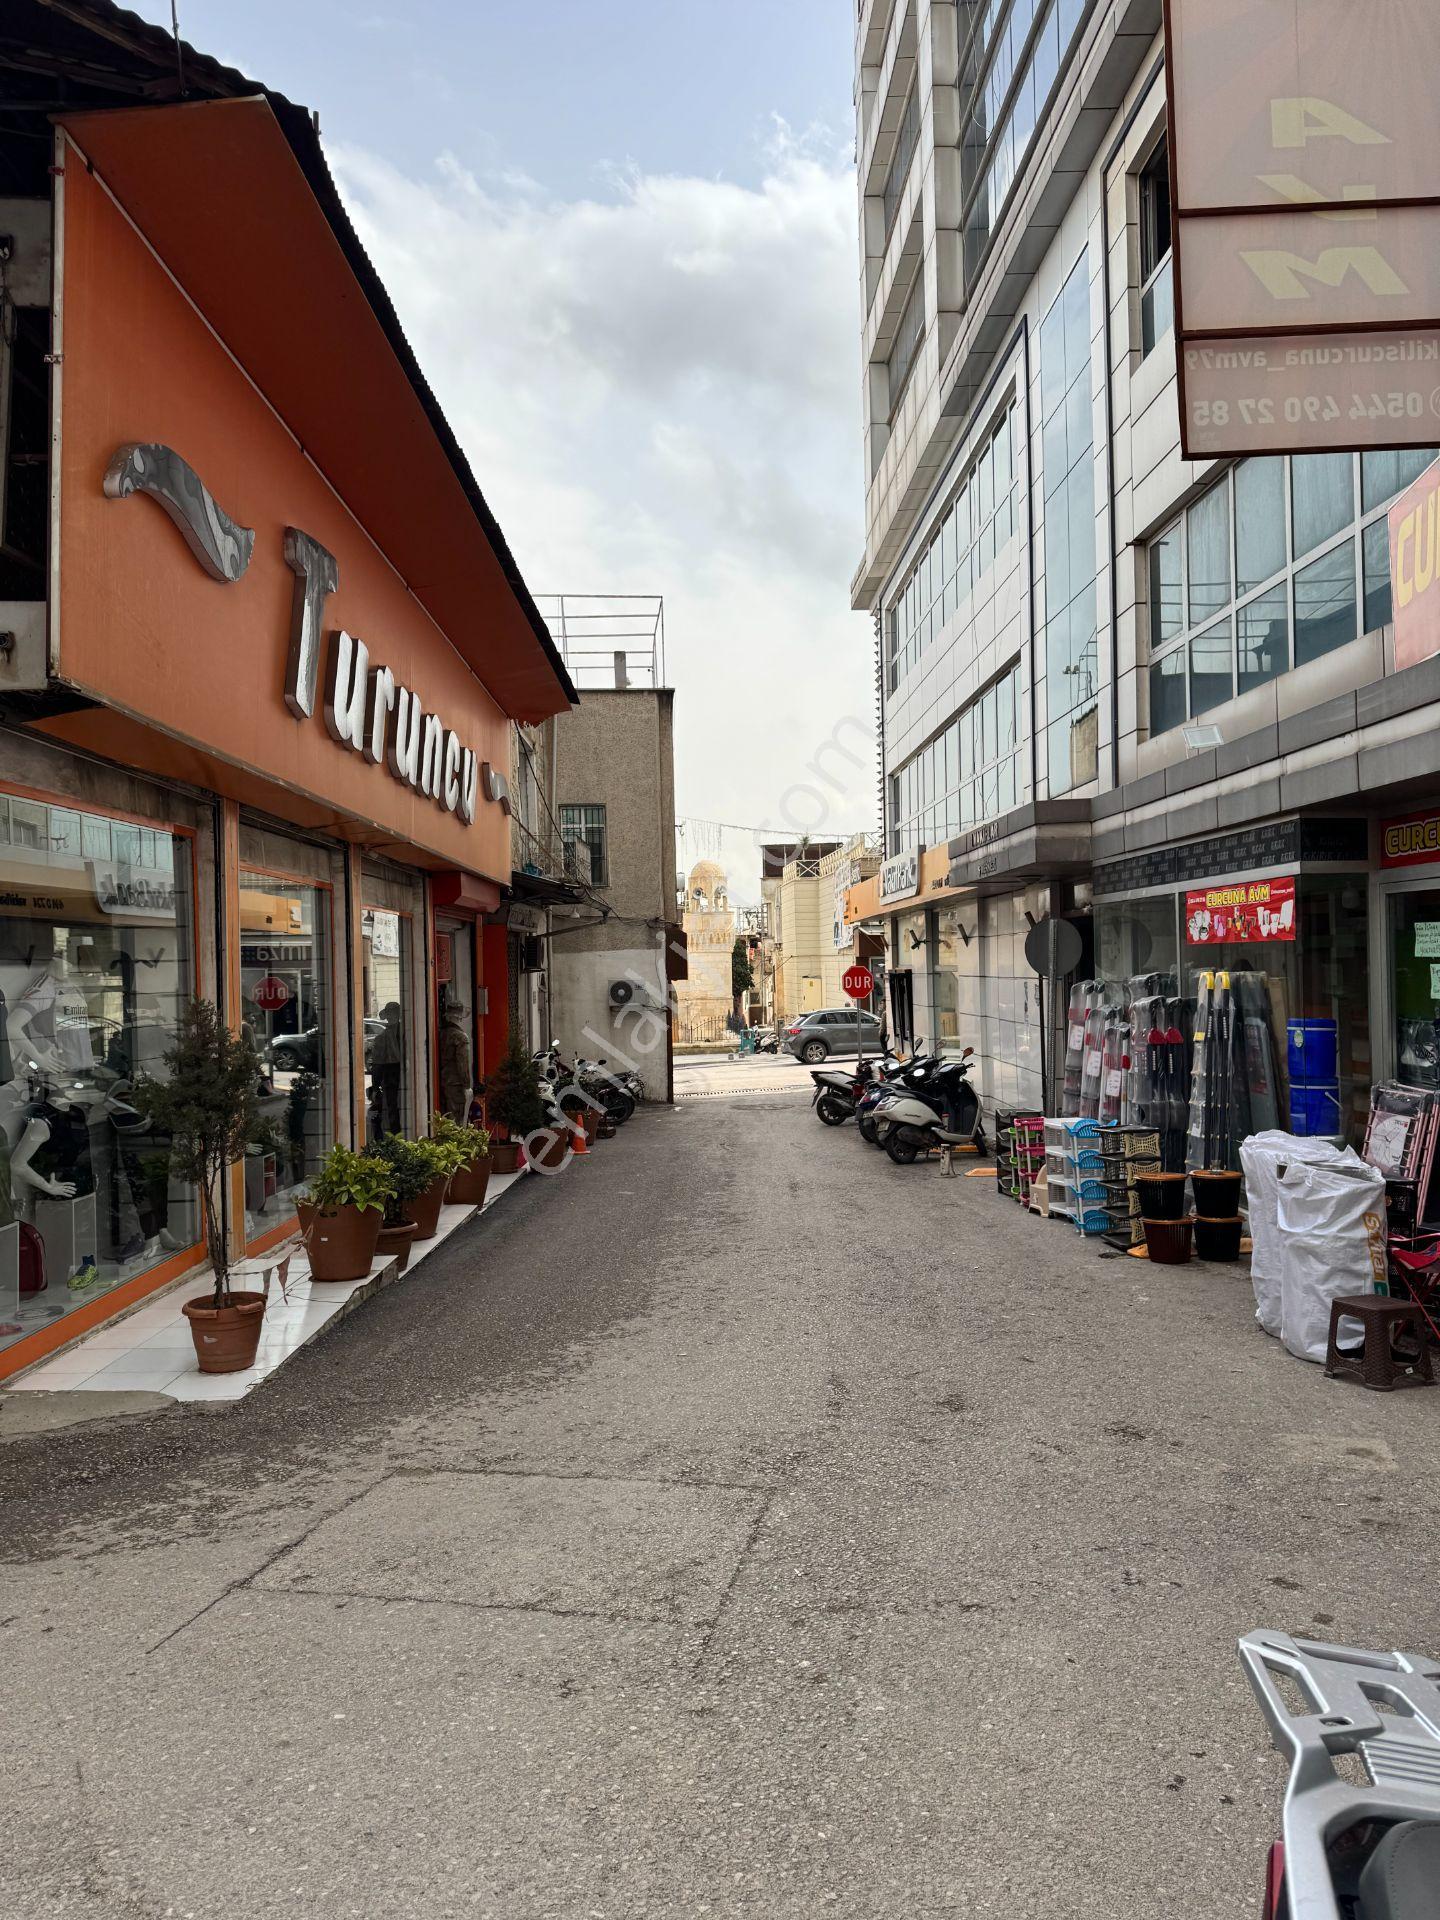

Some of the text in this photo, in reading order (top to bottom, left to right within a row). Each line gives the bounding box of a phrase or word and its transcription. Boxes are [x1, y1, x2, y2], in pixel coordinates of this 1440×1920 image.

[1397, 486, 1440, 608] CU
[284, 526, 478, 827] Turuncu
[1206, 888, 1247, 908] CURCUNA
[845, 976, 871, 989] DUR
